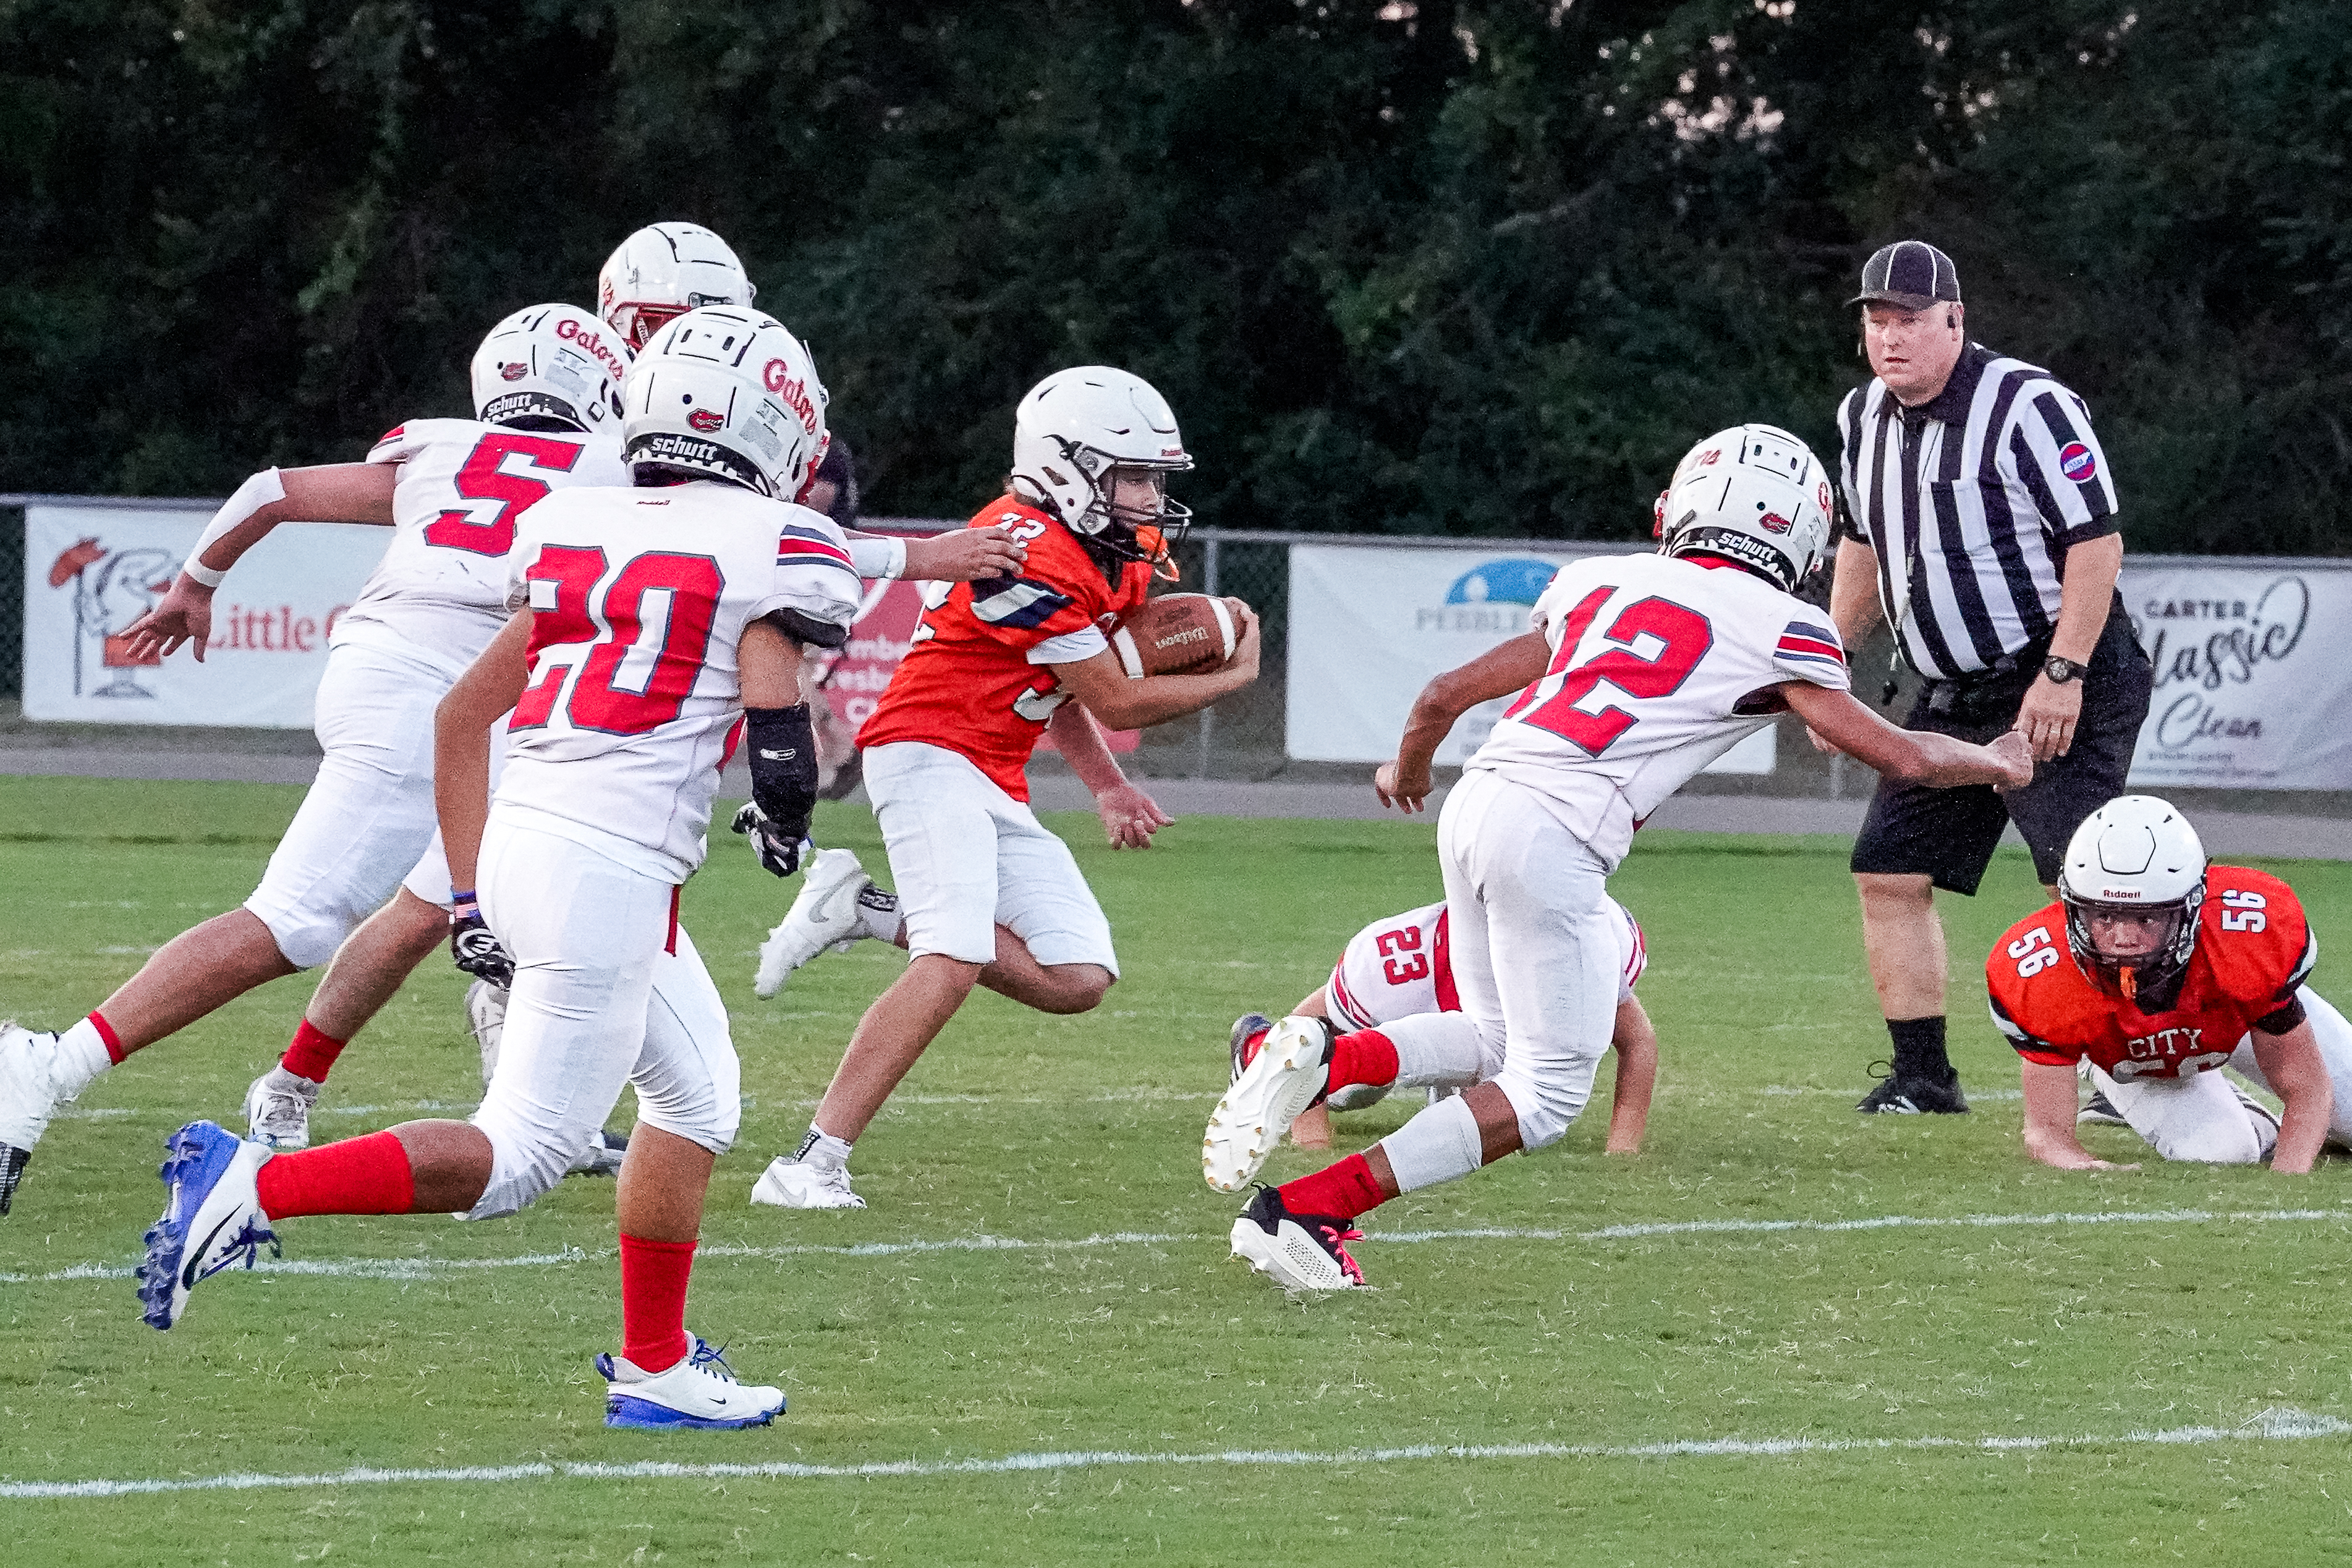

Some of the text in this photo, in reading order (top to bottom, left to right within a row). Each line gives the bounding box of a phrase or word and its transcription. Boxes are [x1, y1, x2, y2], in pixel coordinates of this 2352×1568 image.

[556, 319, 623, 381] Gators
[487, 393, 532, 417] schutt
[650, 436, 717, 460] schutt
[423, 431, 585, 557] 5
[1718, 532, 1777, 562] schutt
[2143, 600, 2248, 619] CARTER
[507, 543, 726, 736] 20
[1503, 585, 1714, 760] 12
[2156, 692, 2263, 749] Clean
[2222, 889, 2267, 934] 56
[1376, 925, 1430, 986] 23
[2007, 926, 2060, 979] 56
[2128, 1028, 2202, 1058] CITY
